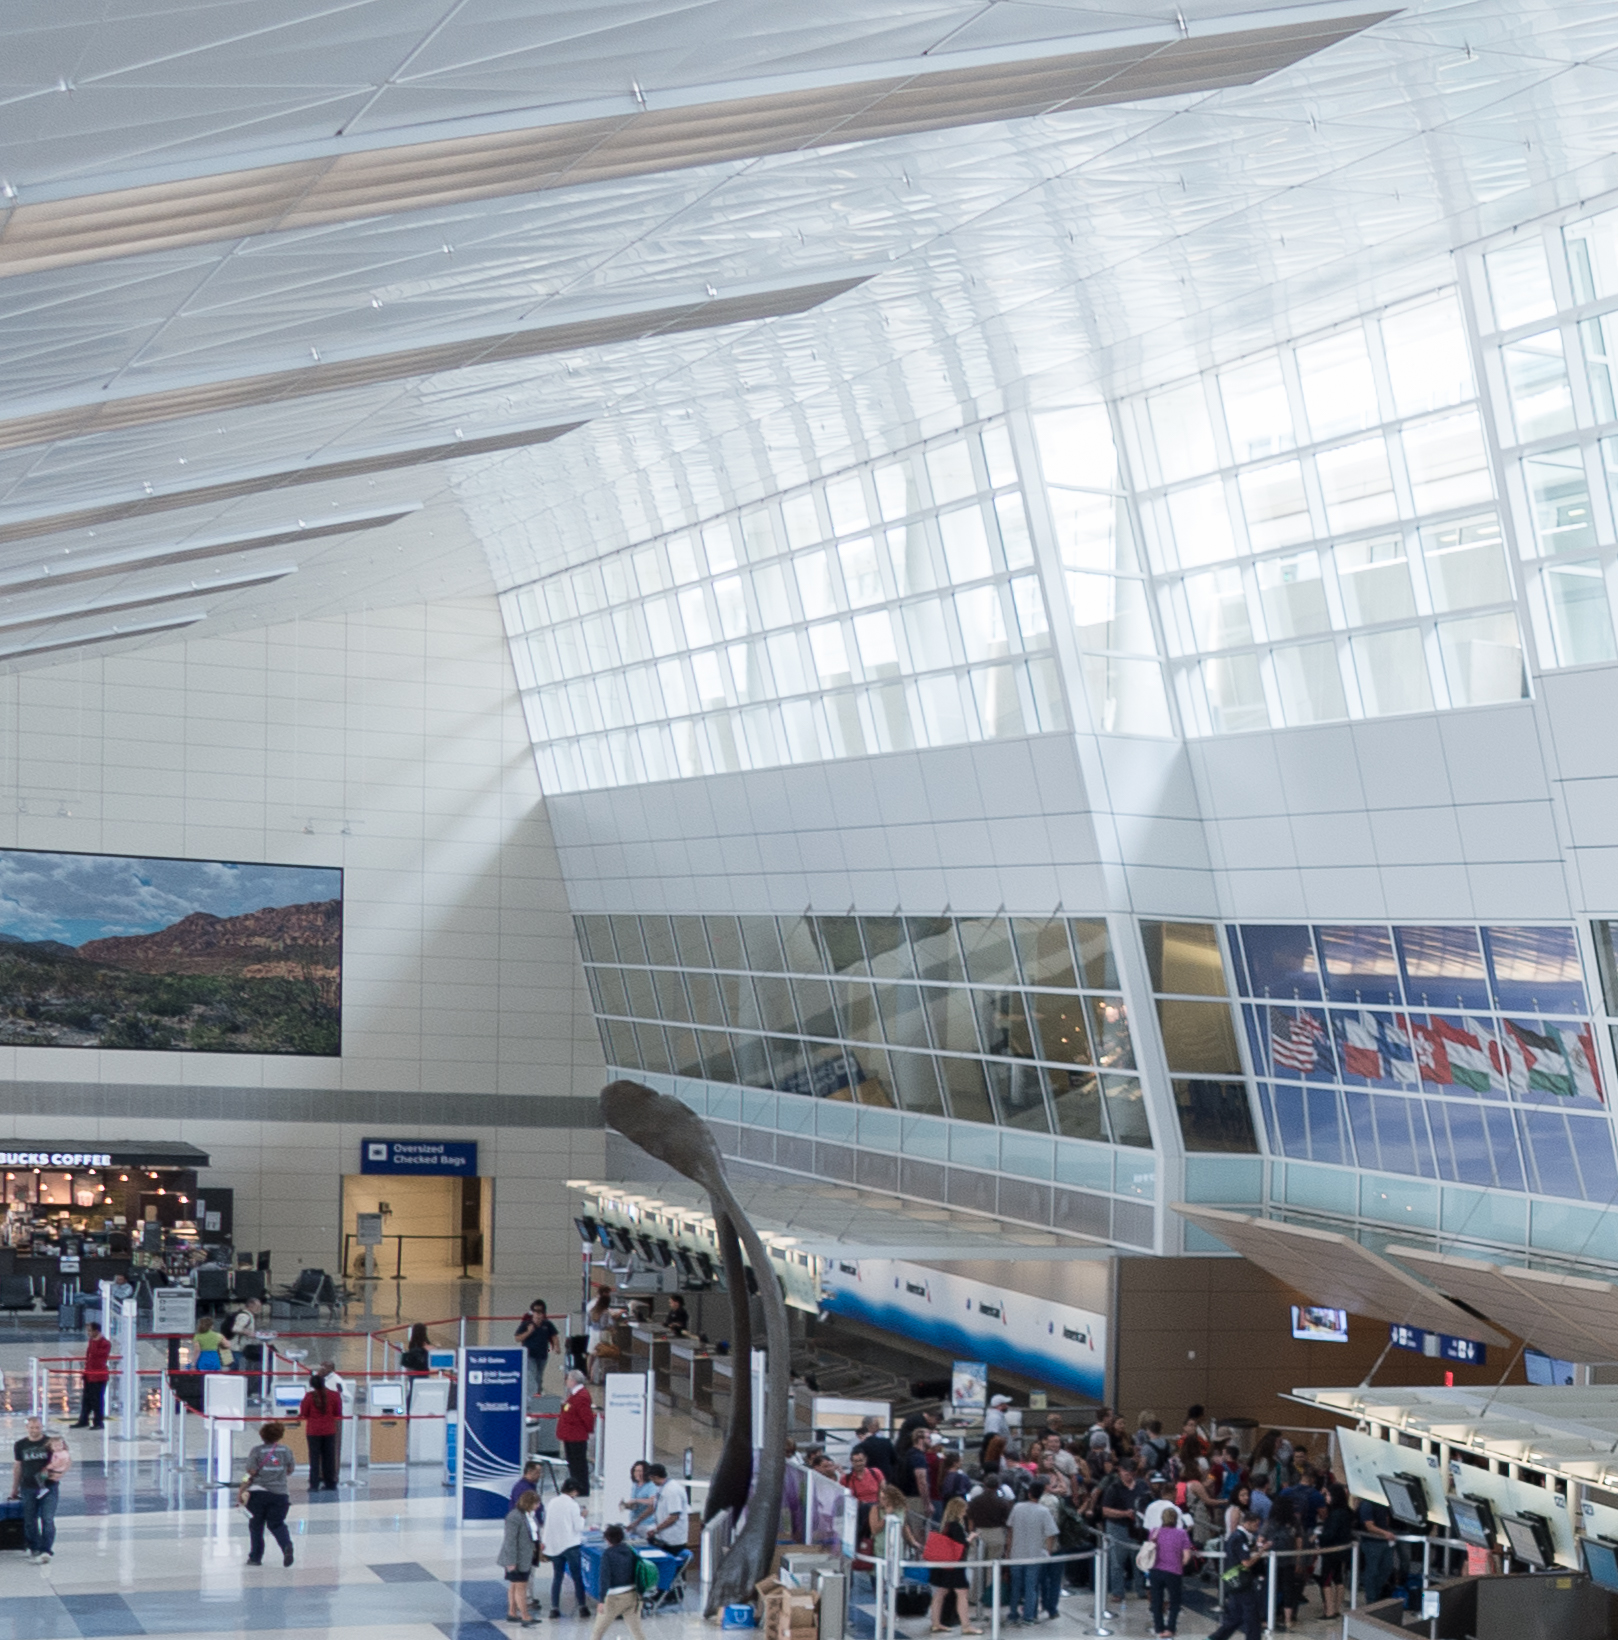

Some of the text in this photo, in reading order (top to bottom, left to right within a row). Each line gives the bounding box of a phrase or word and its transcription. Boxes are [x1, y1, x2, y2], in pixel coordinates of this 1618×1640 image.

[393, 1144, 444, 1154] Oversized
[51, 1153, 111, 1166] COFFEE
[393, 1155, 466, 1167] Checked Bags
